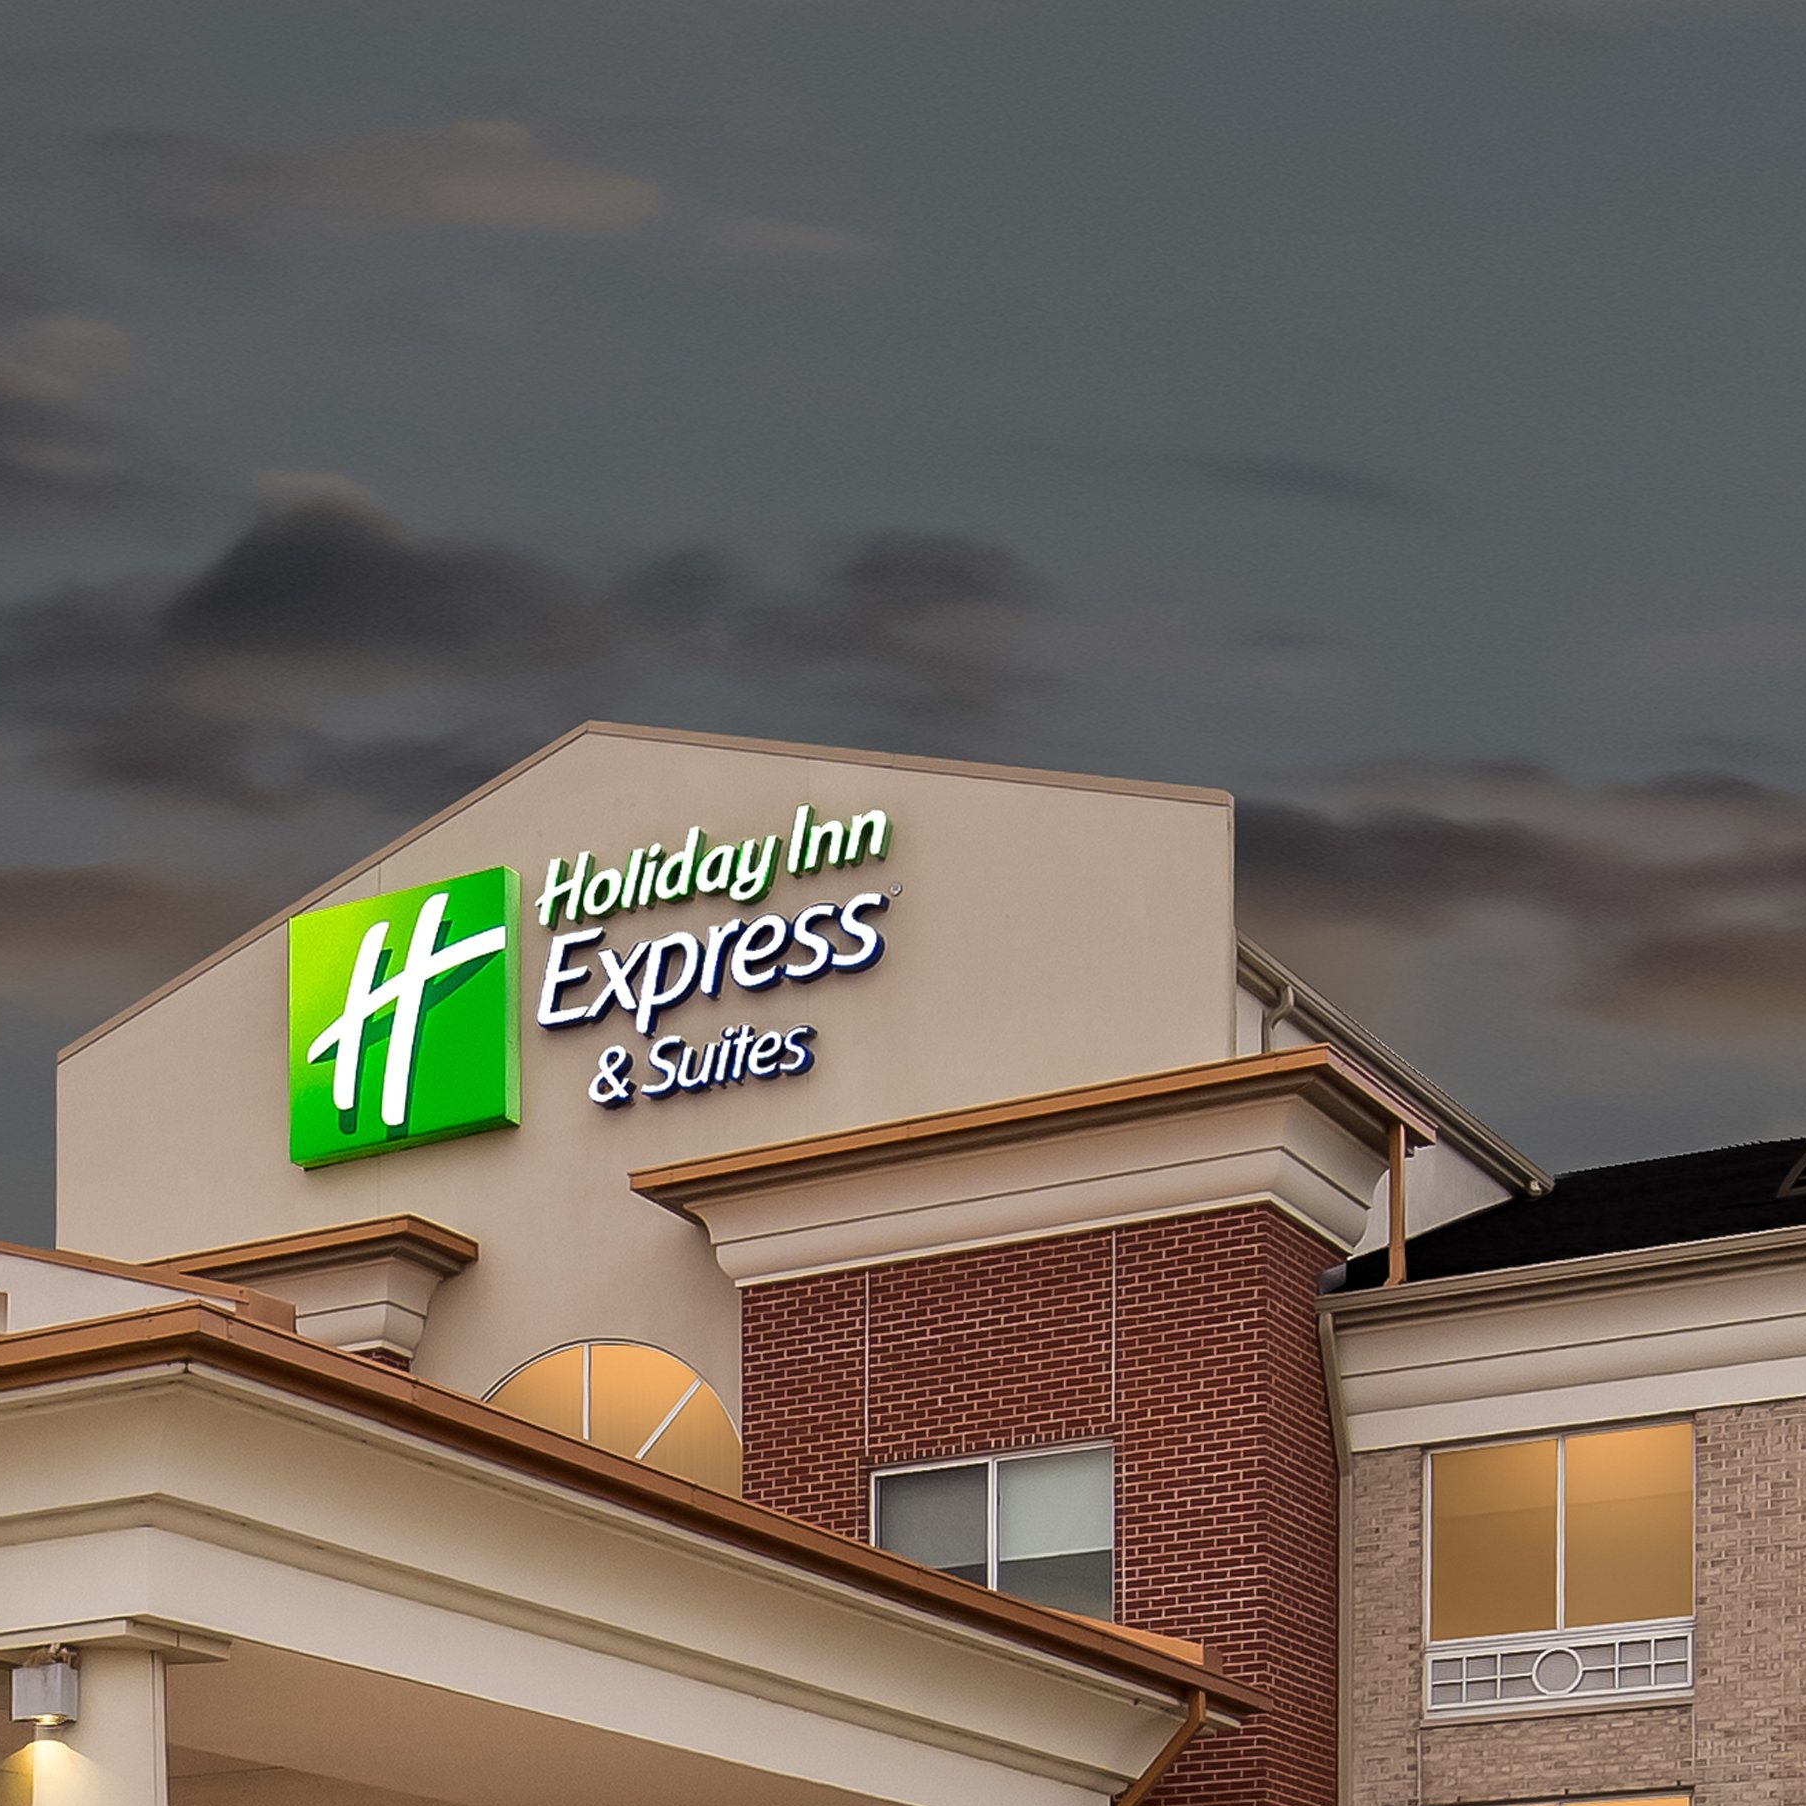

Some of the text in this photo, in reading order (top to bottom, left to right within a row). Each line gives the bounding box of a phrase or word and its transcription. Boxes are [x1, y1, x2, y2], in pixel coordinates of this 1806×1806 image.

[535, 803, 889, 928] Holiday Inn
[536, 892, 886, 1035] Express
[587, 1025, 813, 1104] & Suites
